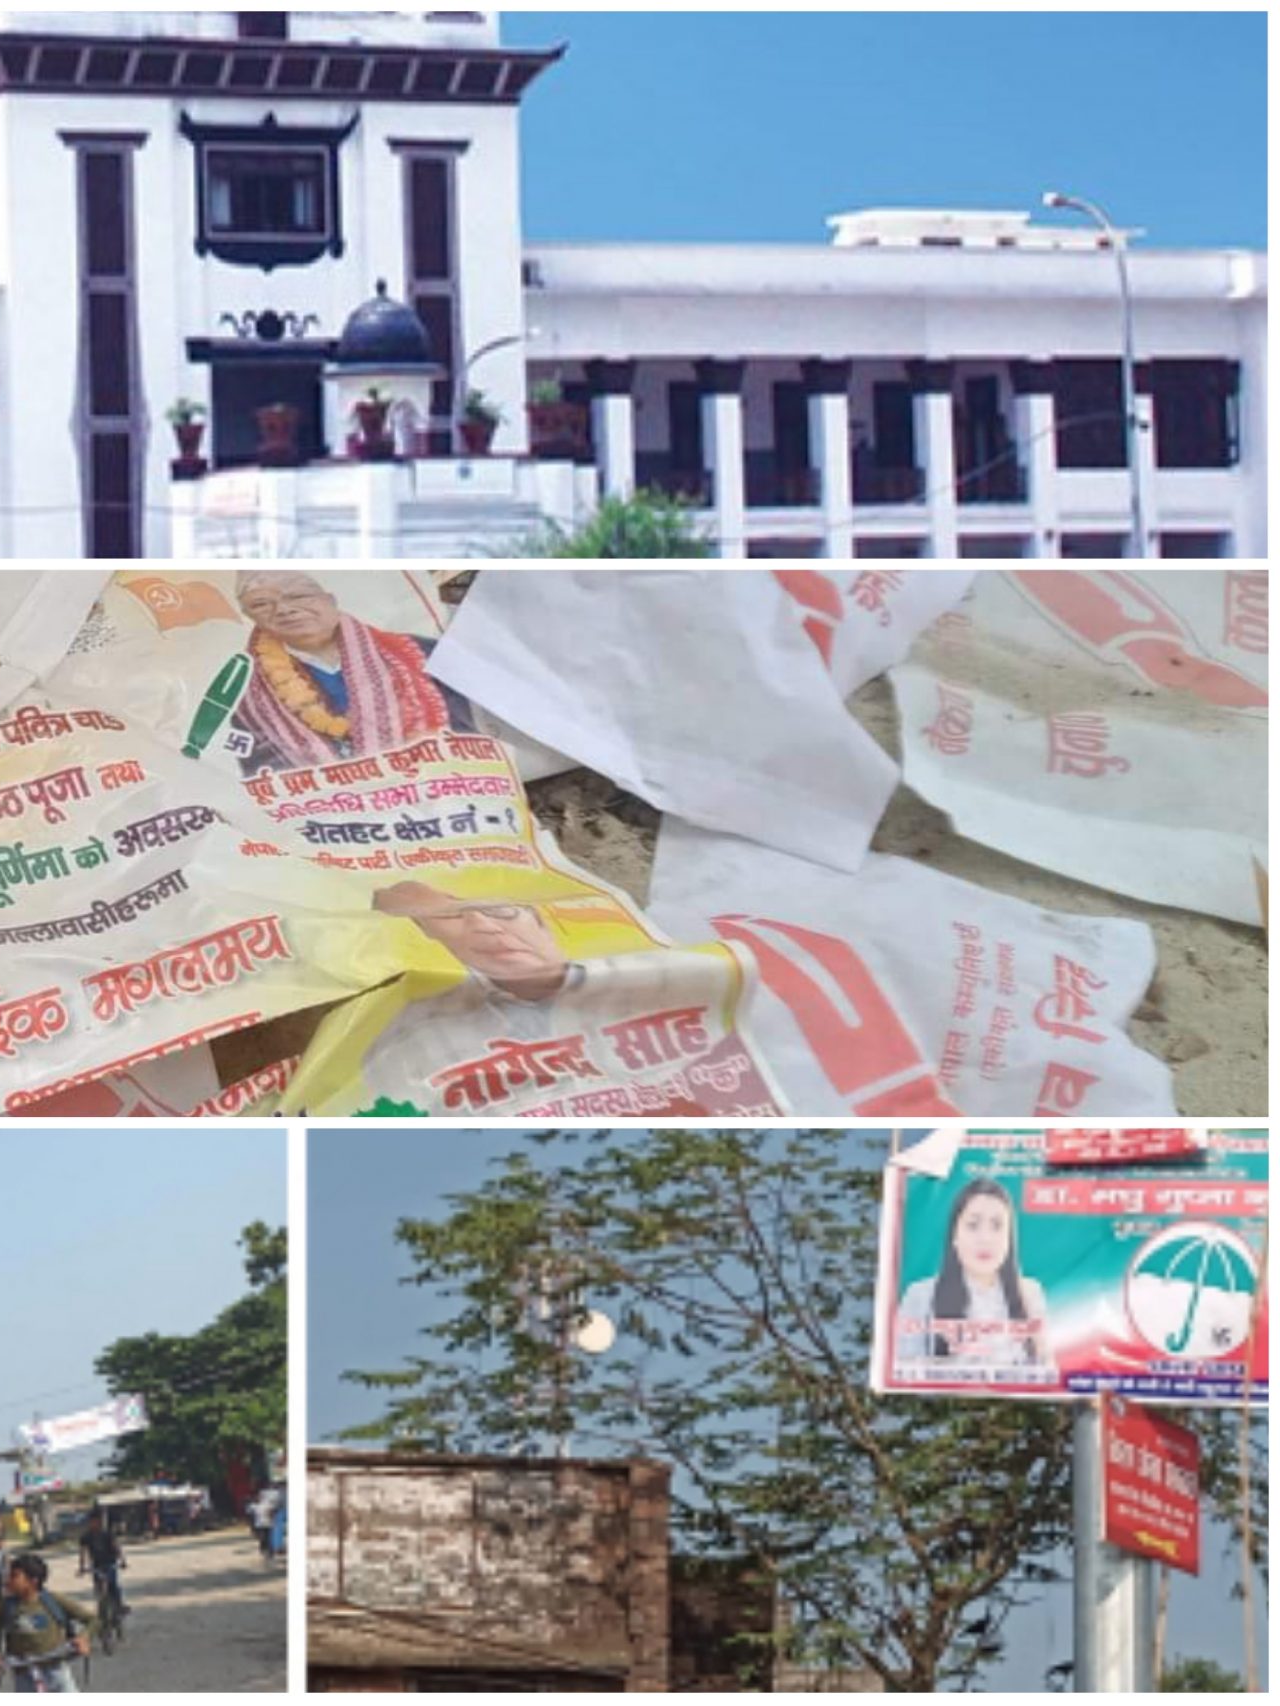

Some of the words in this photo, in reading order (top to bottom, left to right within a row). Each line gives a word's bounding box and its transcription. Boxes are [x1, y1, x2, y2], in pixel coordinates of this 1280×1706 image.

[0, 705, 73, 746] पवित्र
[241, 768, 279, 806] पूर्व
[382, 739, 445, 778] कुमार
[443, 730, 503, 762] नेपाल
[25, 765, 91, 825] पूजा
[96, 759, 145, 790] तथा
[365, 783, 420, 812] सभा
[447, 803, 478, 834] नं
[70, 839, 110, 870] को
[429, 1034, 606, 1111] नागेन्द्र
[601, 1006, 712, 1072] साह
